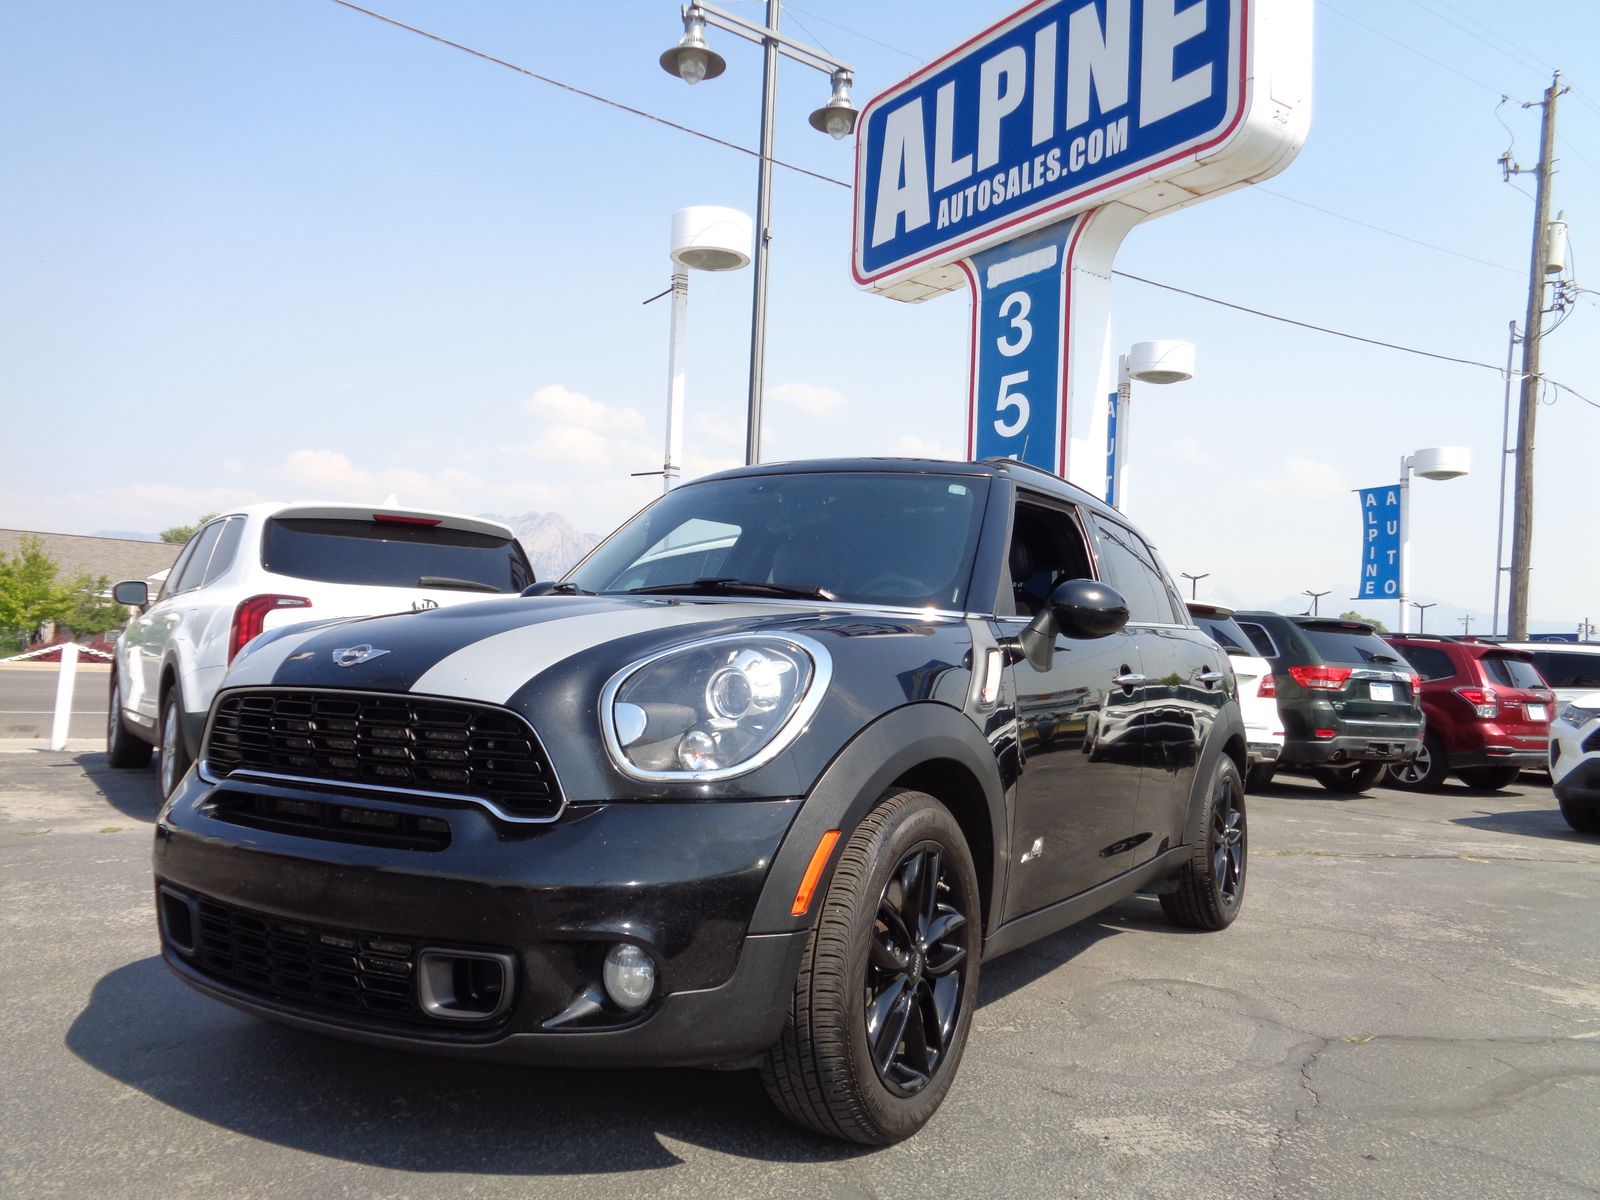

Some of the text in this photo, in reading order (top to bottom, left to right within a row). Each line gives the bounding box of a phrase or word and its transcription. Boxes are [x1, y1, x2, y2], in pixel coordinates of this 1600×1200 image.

[871, 0, 1213, 248] ALPINE
[936, 116, 1129, 230] AUTOSALES.COM
[1365, 493, 1378, 594] ALPINE
[1384, 491, 1397, 594] AUTO
